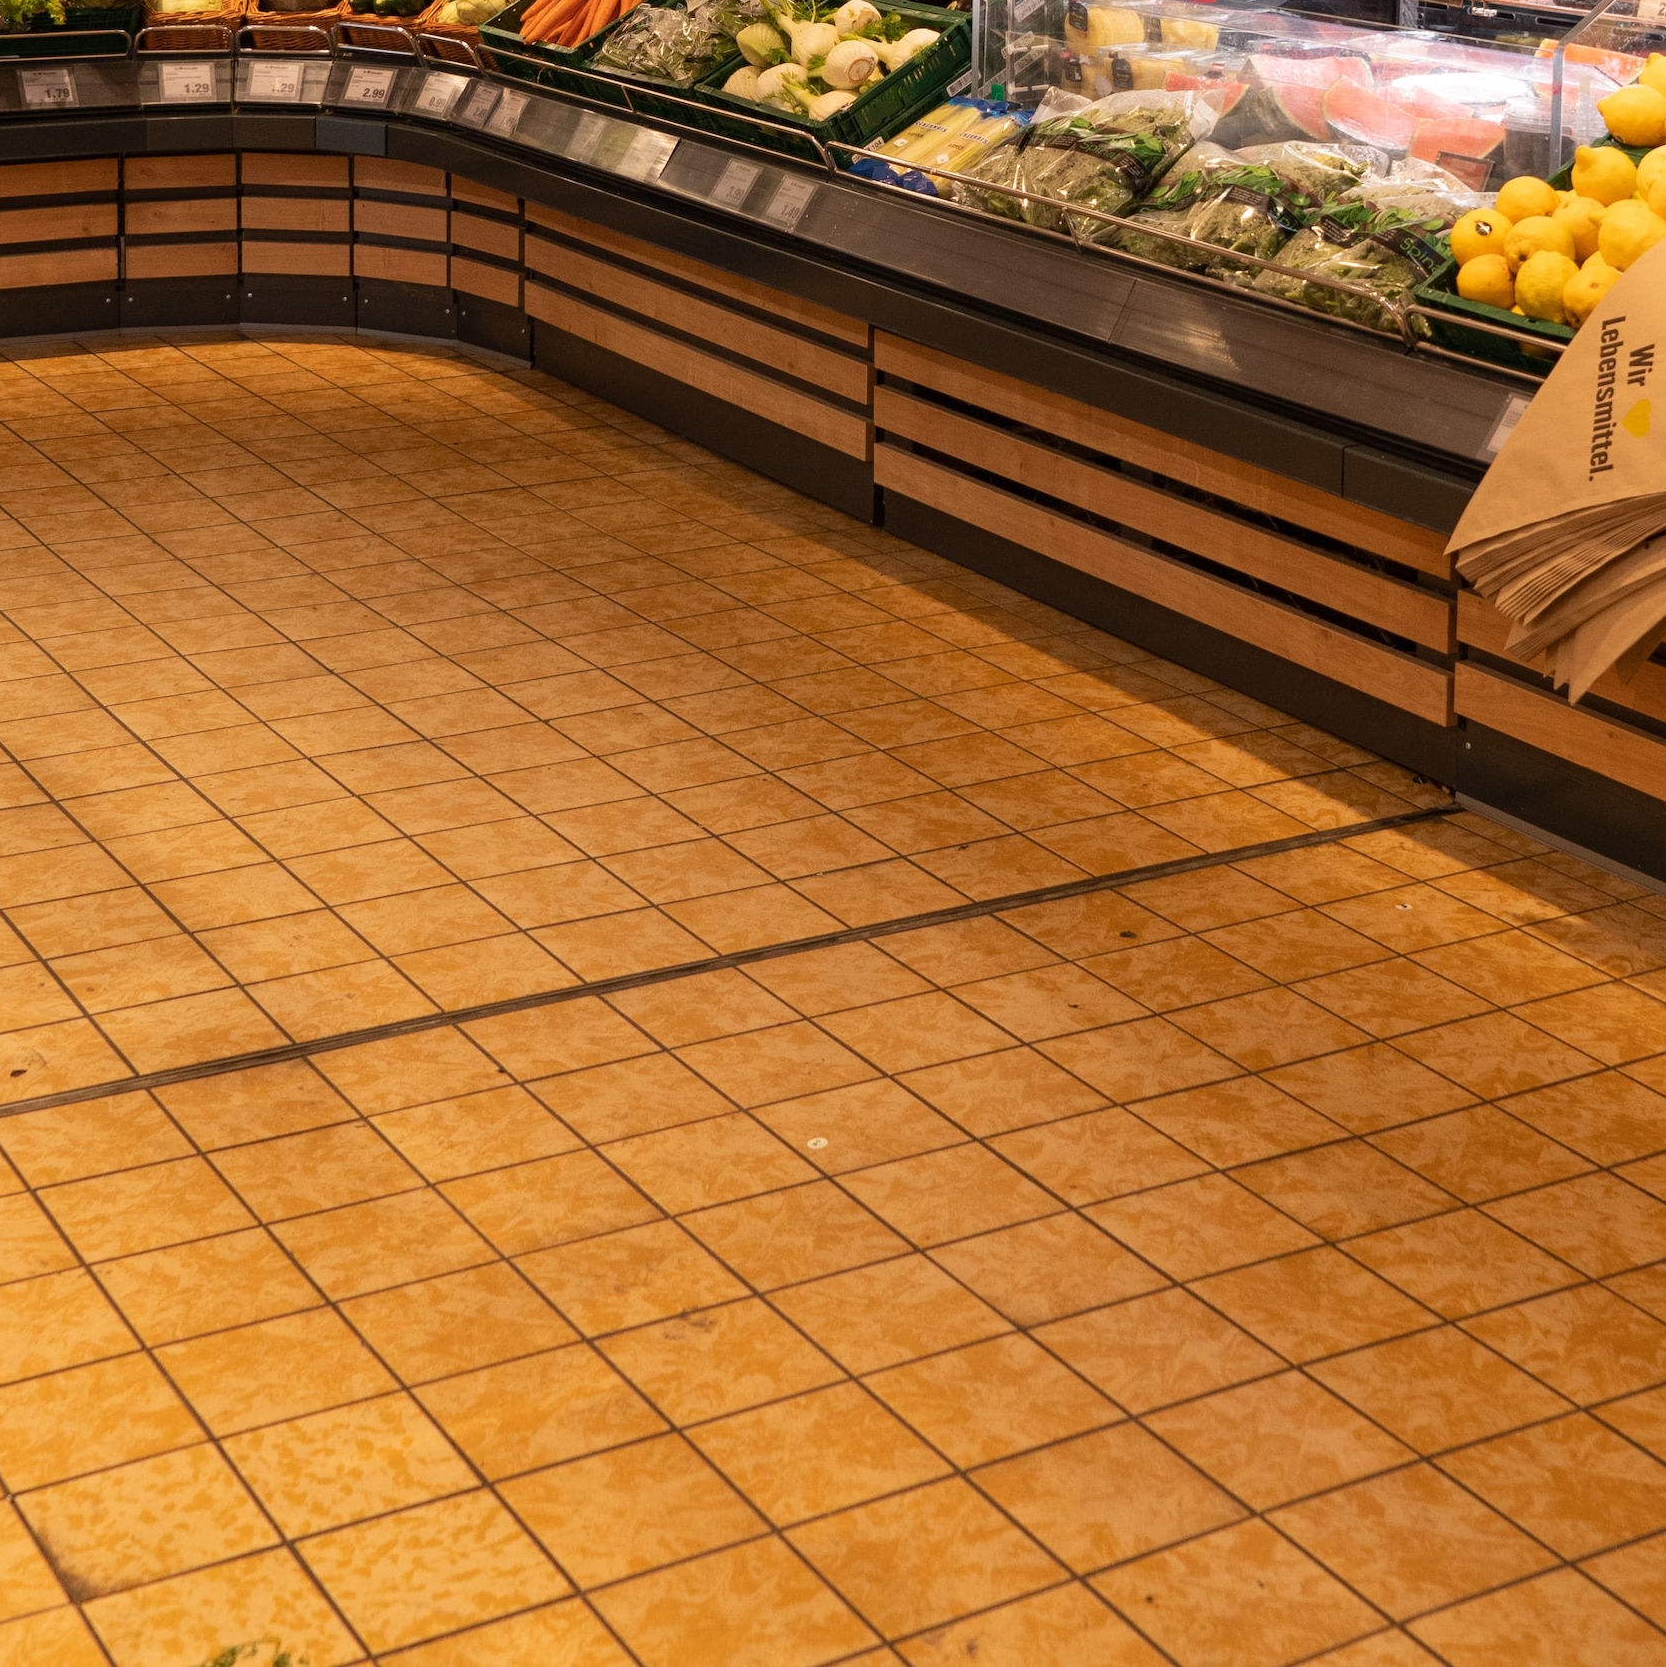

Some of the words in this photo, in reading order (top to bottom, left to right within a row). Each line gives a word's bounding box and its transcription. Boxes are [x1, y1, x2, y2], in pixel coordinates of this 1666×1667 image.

[45, 88, 70, 98] 1.79
[183, 83, 210, 93] 1.29
[363, 88, 385, 99] 2.99
[1399, 237, 1439, 273] Spina
[1627, 343, 1655, 387] Wir
[1587, 315, 1626, 482] Lebensmittel.
